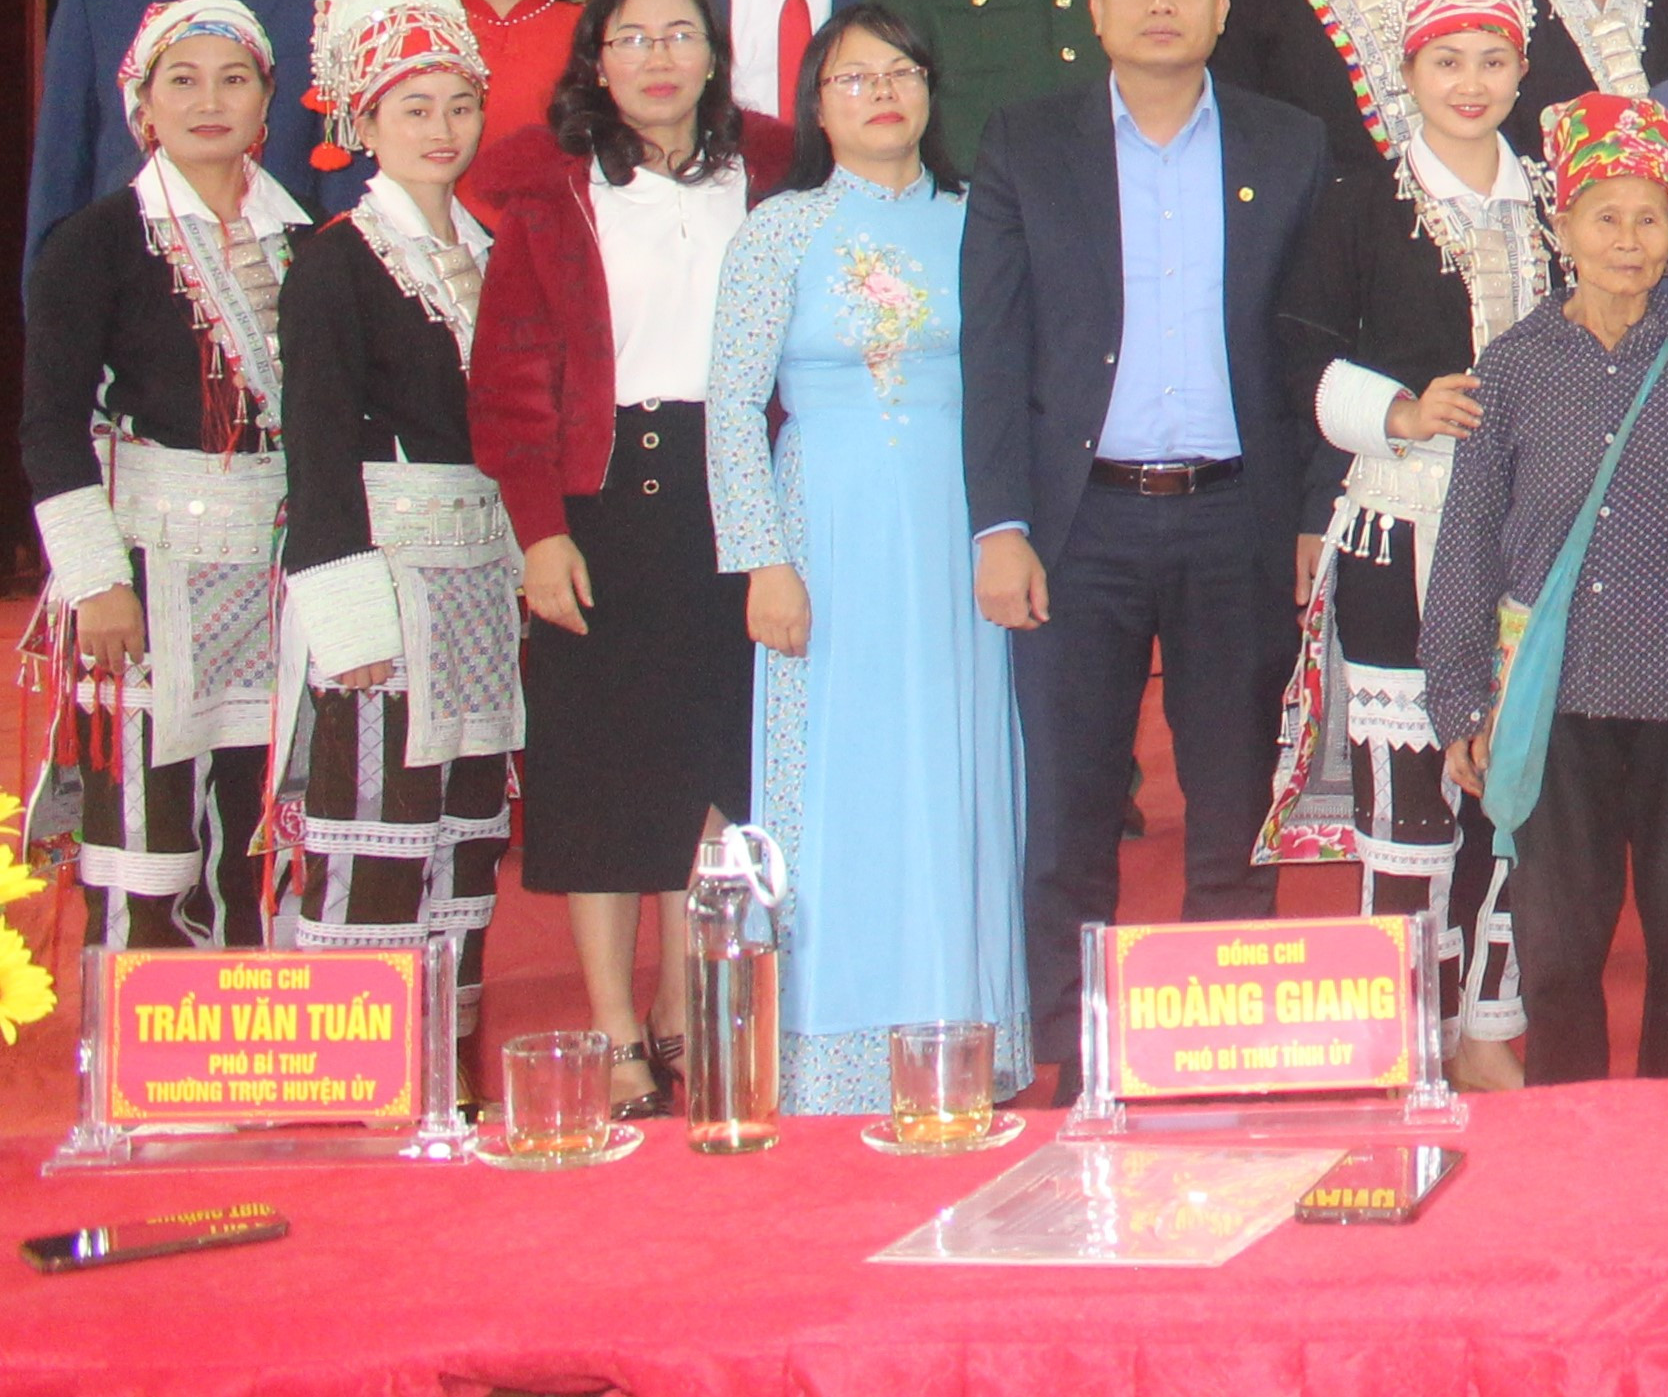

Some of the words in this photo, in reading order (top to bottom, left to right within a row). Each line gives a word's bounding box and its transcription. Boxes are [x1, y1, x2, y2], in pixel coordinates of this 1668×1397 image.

[135, 993, 221, 1041] TRẦN
[231, 998, 296, 1041] VĂN
[307, 992, 392, 1040] TUẤN
[1129, 977, 1264, 1029] HOÀNG
[1275, 977, 1396, 1022] GIANG
[1330, 1039, 1354, 1065] ỦY
[146, 1078, 222, 1102] THƯỜNG
[228, 1080, 277, 1105] TRỰC
[283, 1078, 345, 1104] HUYỆN
[351, 1074, 376, 1101] ỦY
